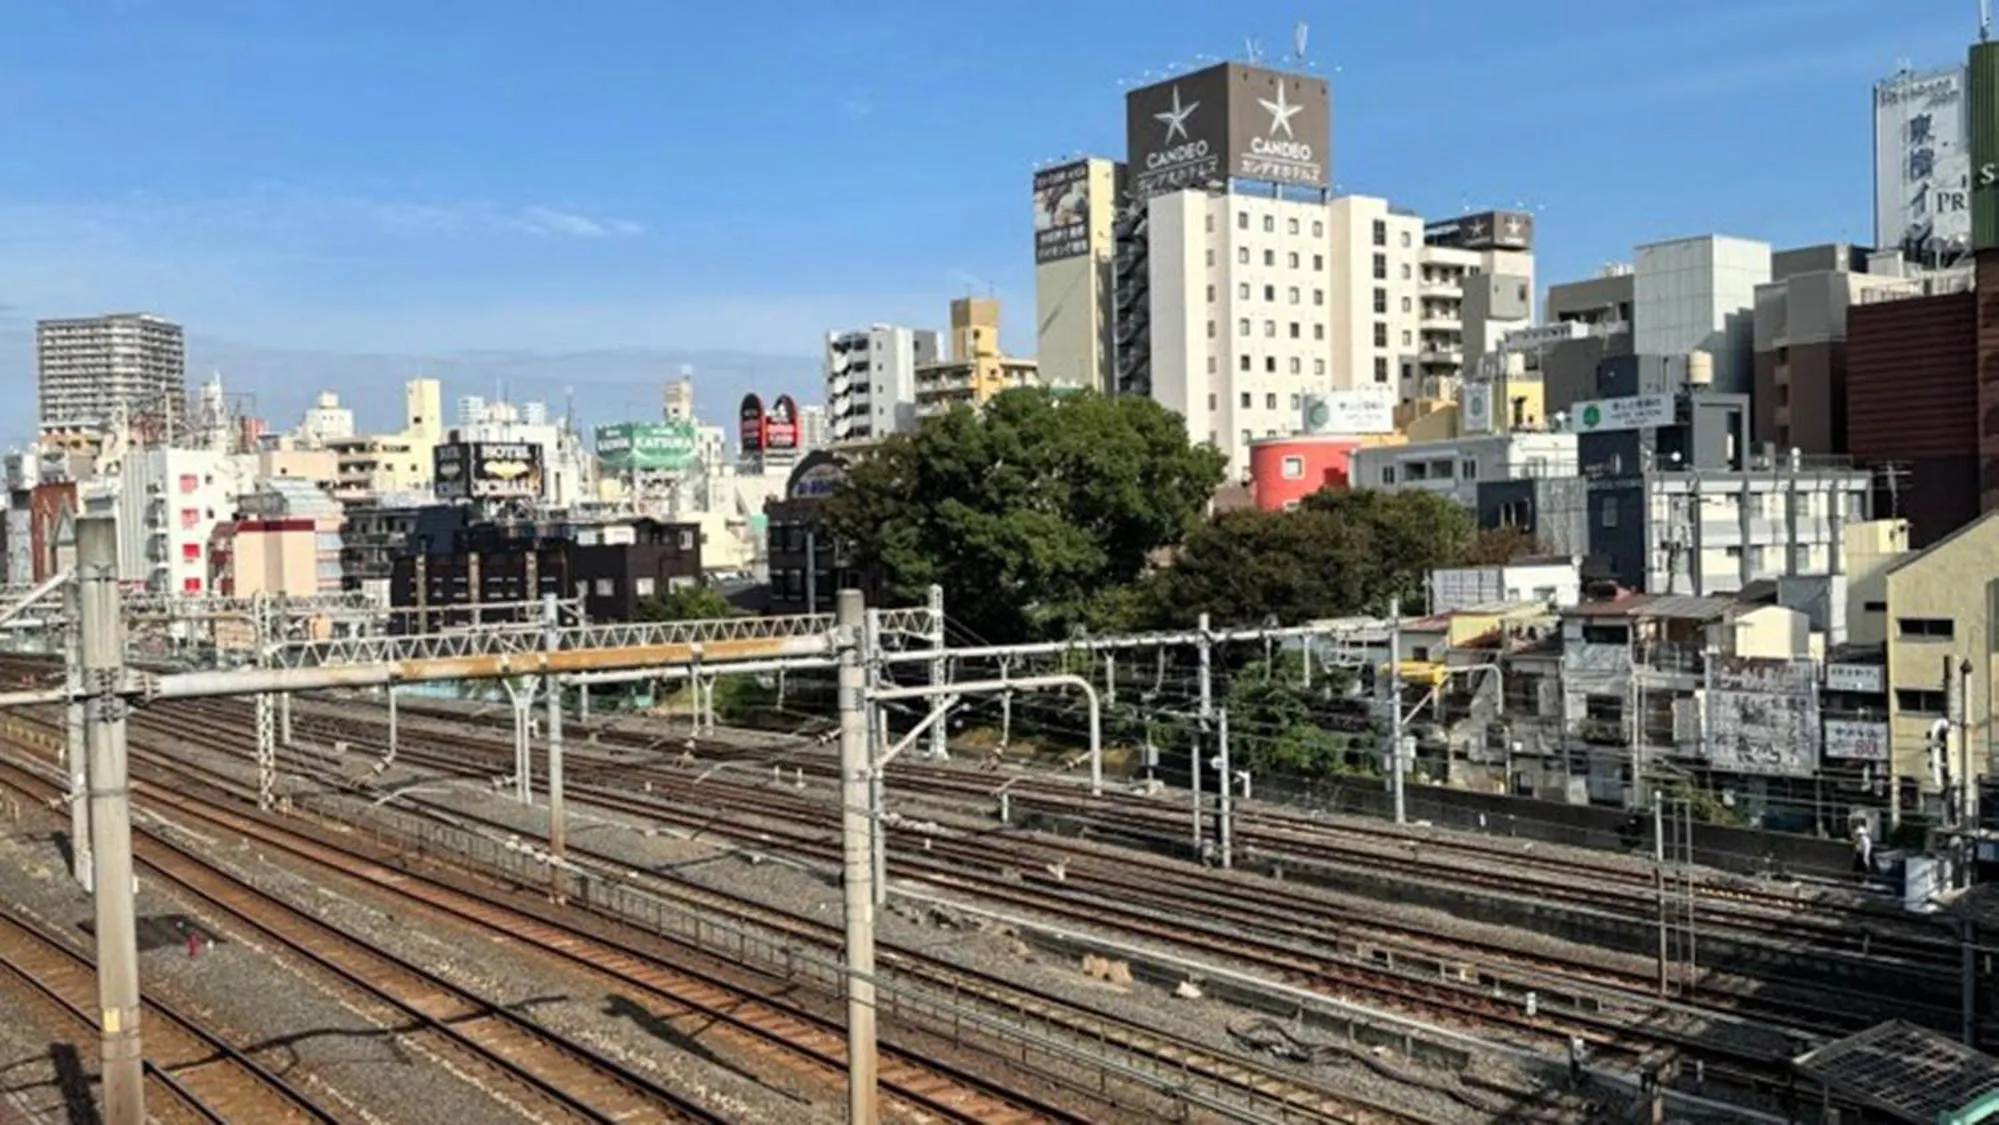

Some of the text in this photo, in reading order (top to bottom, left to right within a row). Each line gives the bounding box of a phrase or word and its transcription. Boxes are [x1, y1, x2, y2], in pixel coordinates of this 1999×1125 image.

[1146, 140, 1209, 169] CANDEO
[1251, 136, 1312, 160] CANDEO
[1240, 158, 1321, 182] カンデオホテルズ
